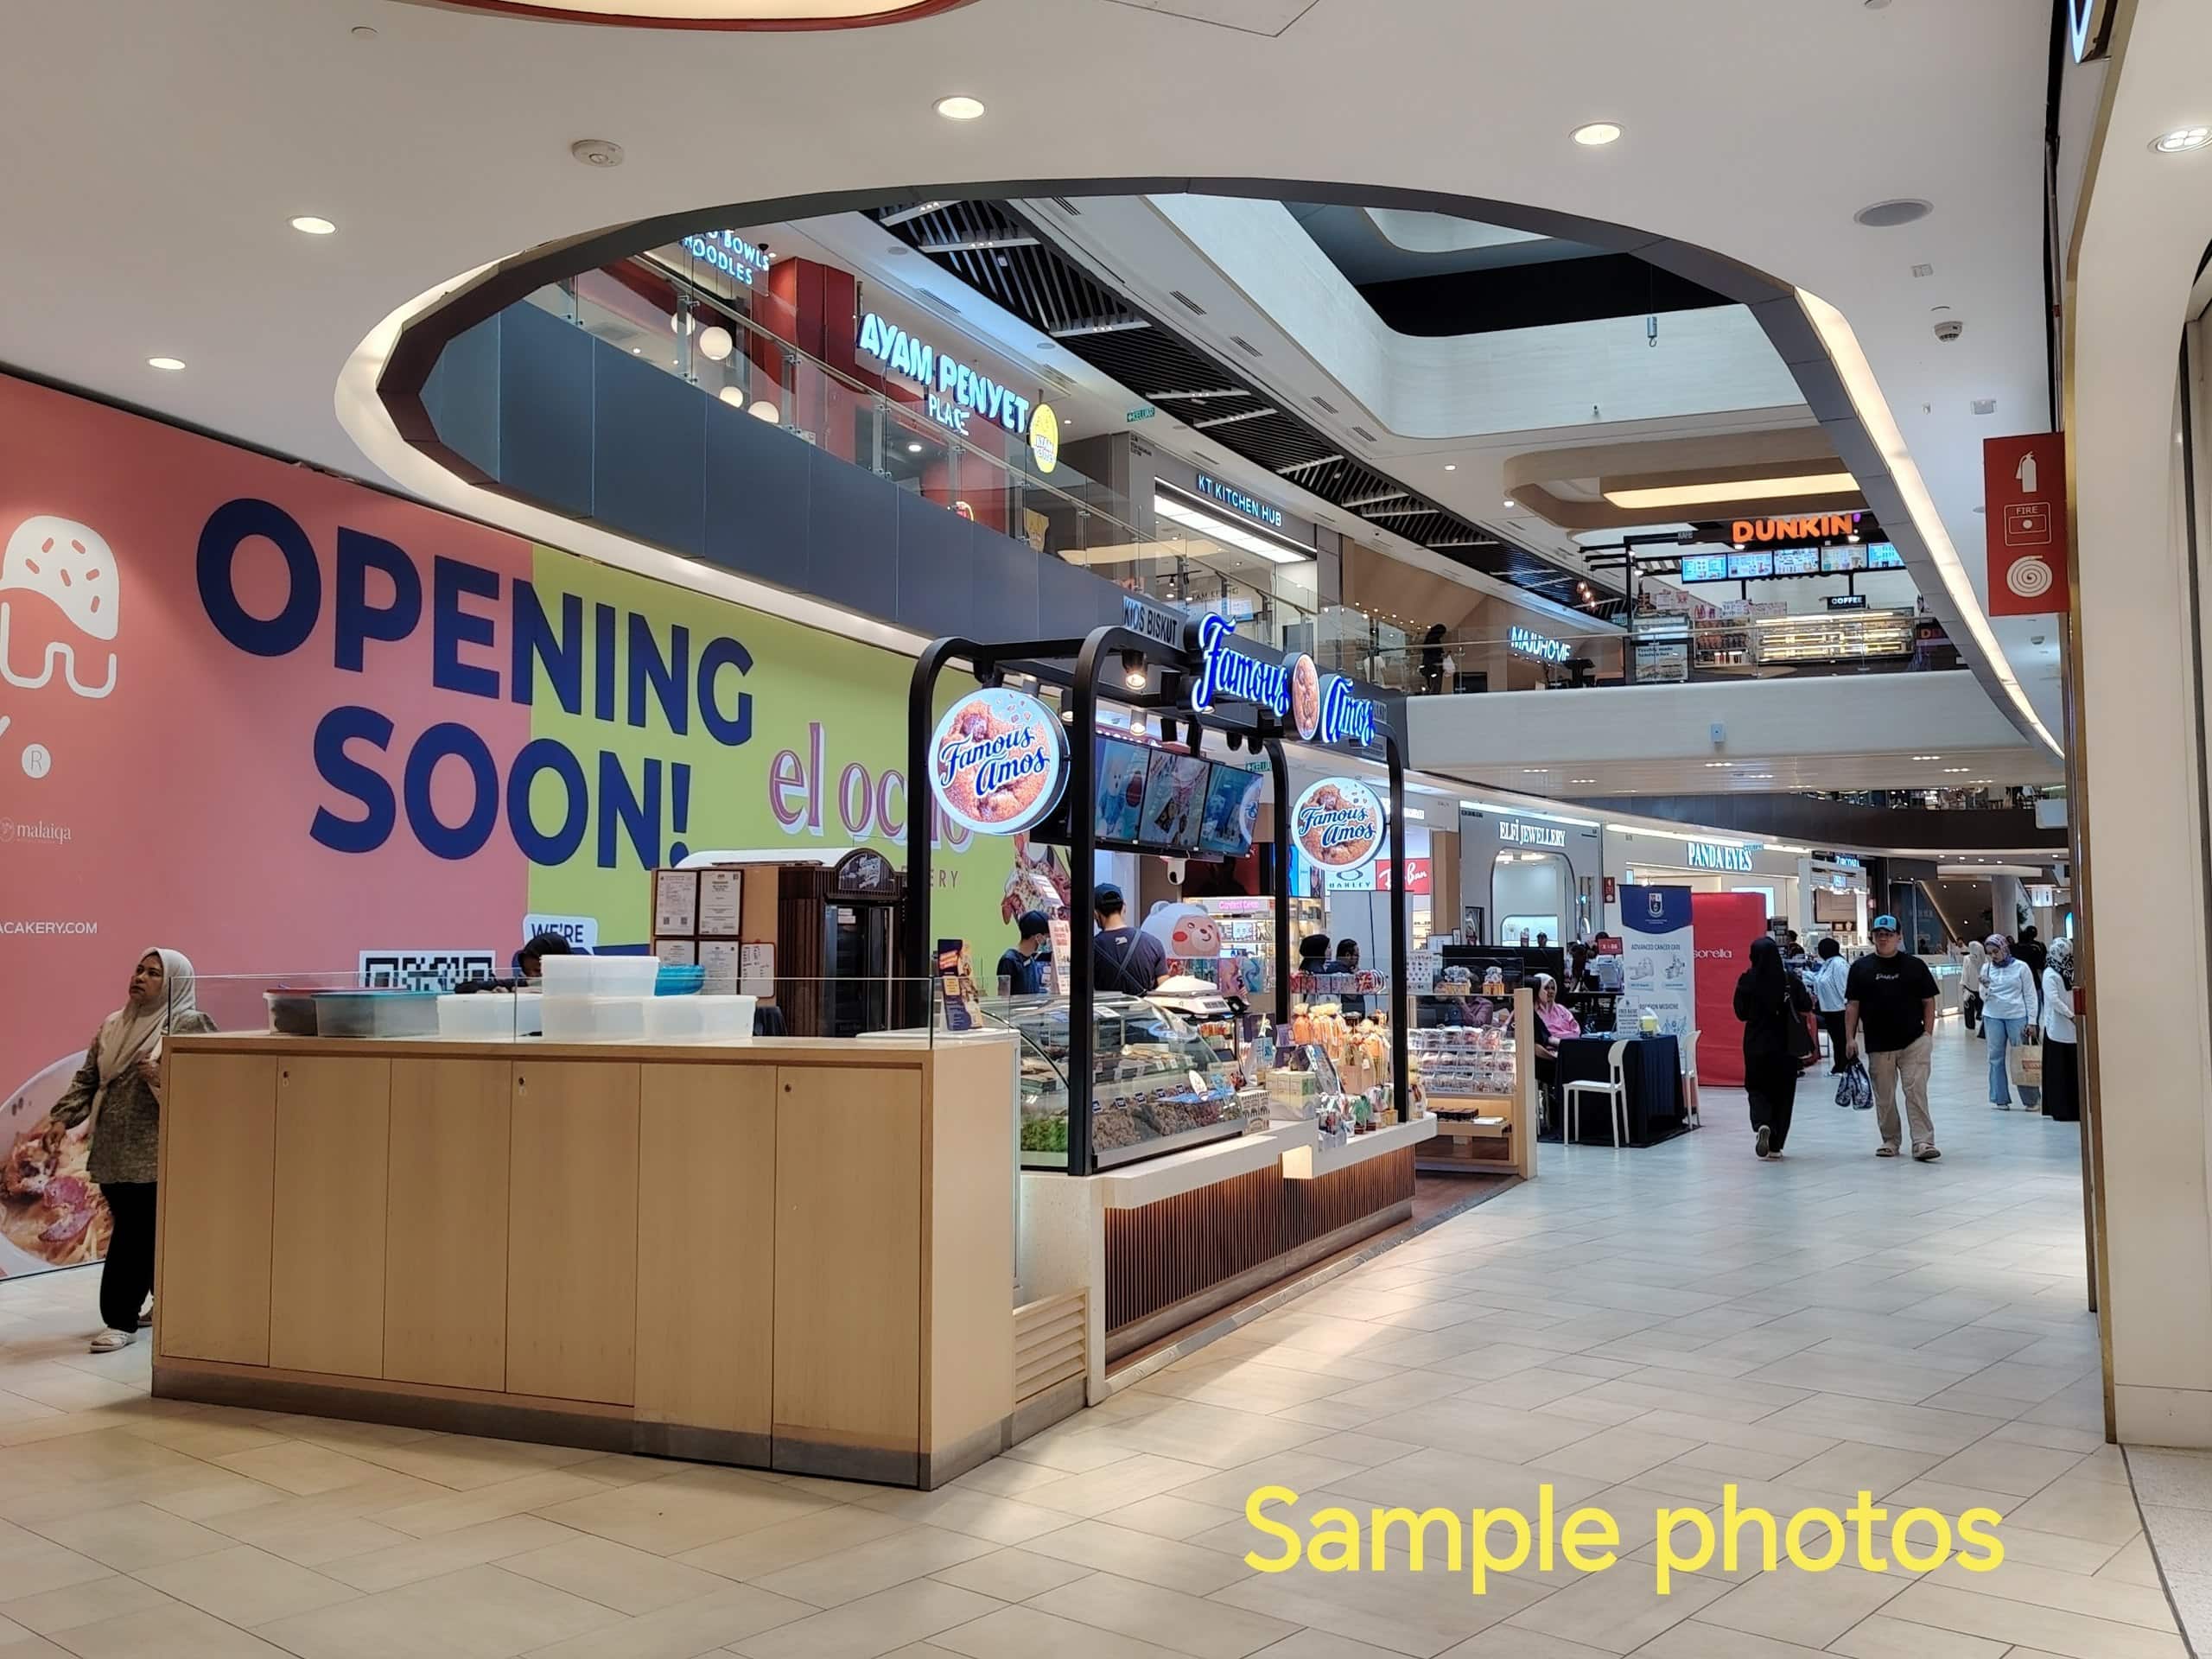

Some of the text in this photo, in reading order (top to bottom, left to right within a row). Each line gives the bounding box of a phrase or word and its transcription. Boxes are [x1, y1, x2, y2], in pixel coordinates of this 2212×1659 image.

[859, 313, 1030, 434] AYAM PENYET
[928, 394, 969, 435] PLACE
[1198, 474, 1283, 527] KT KITCHEN HUB
[2016, 506, 2038, 515] FIRE
[196, 498, 754, 747] OPENING
[1124, 599, 1178, 646] KIOS BISKUT
[1831, 596, 1863, 605] COFFEE
[1192, 613, 1376, 747] Famous Amos
[769, 721, 824, 835] el
[939, 726, 1034, 787] Famous
[975, 744, 1051, 798] Amos
[309, 706, 690, 871] SOON!
[16, 821, 72, 844] malaiqa
[1299, 804, 1369, 836] Famous
[1321, 823, 1376, 847] Amos
[1520, 825, 1566, 847] JEWELLERY
[1687, 842, 1753, 872] PANDA EYES
[1693, 949, 1732, 958] sorella
